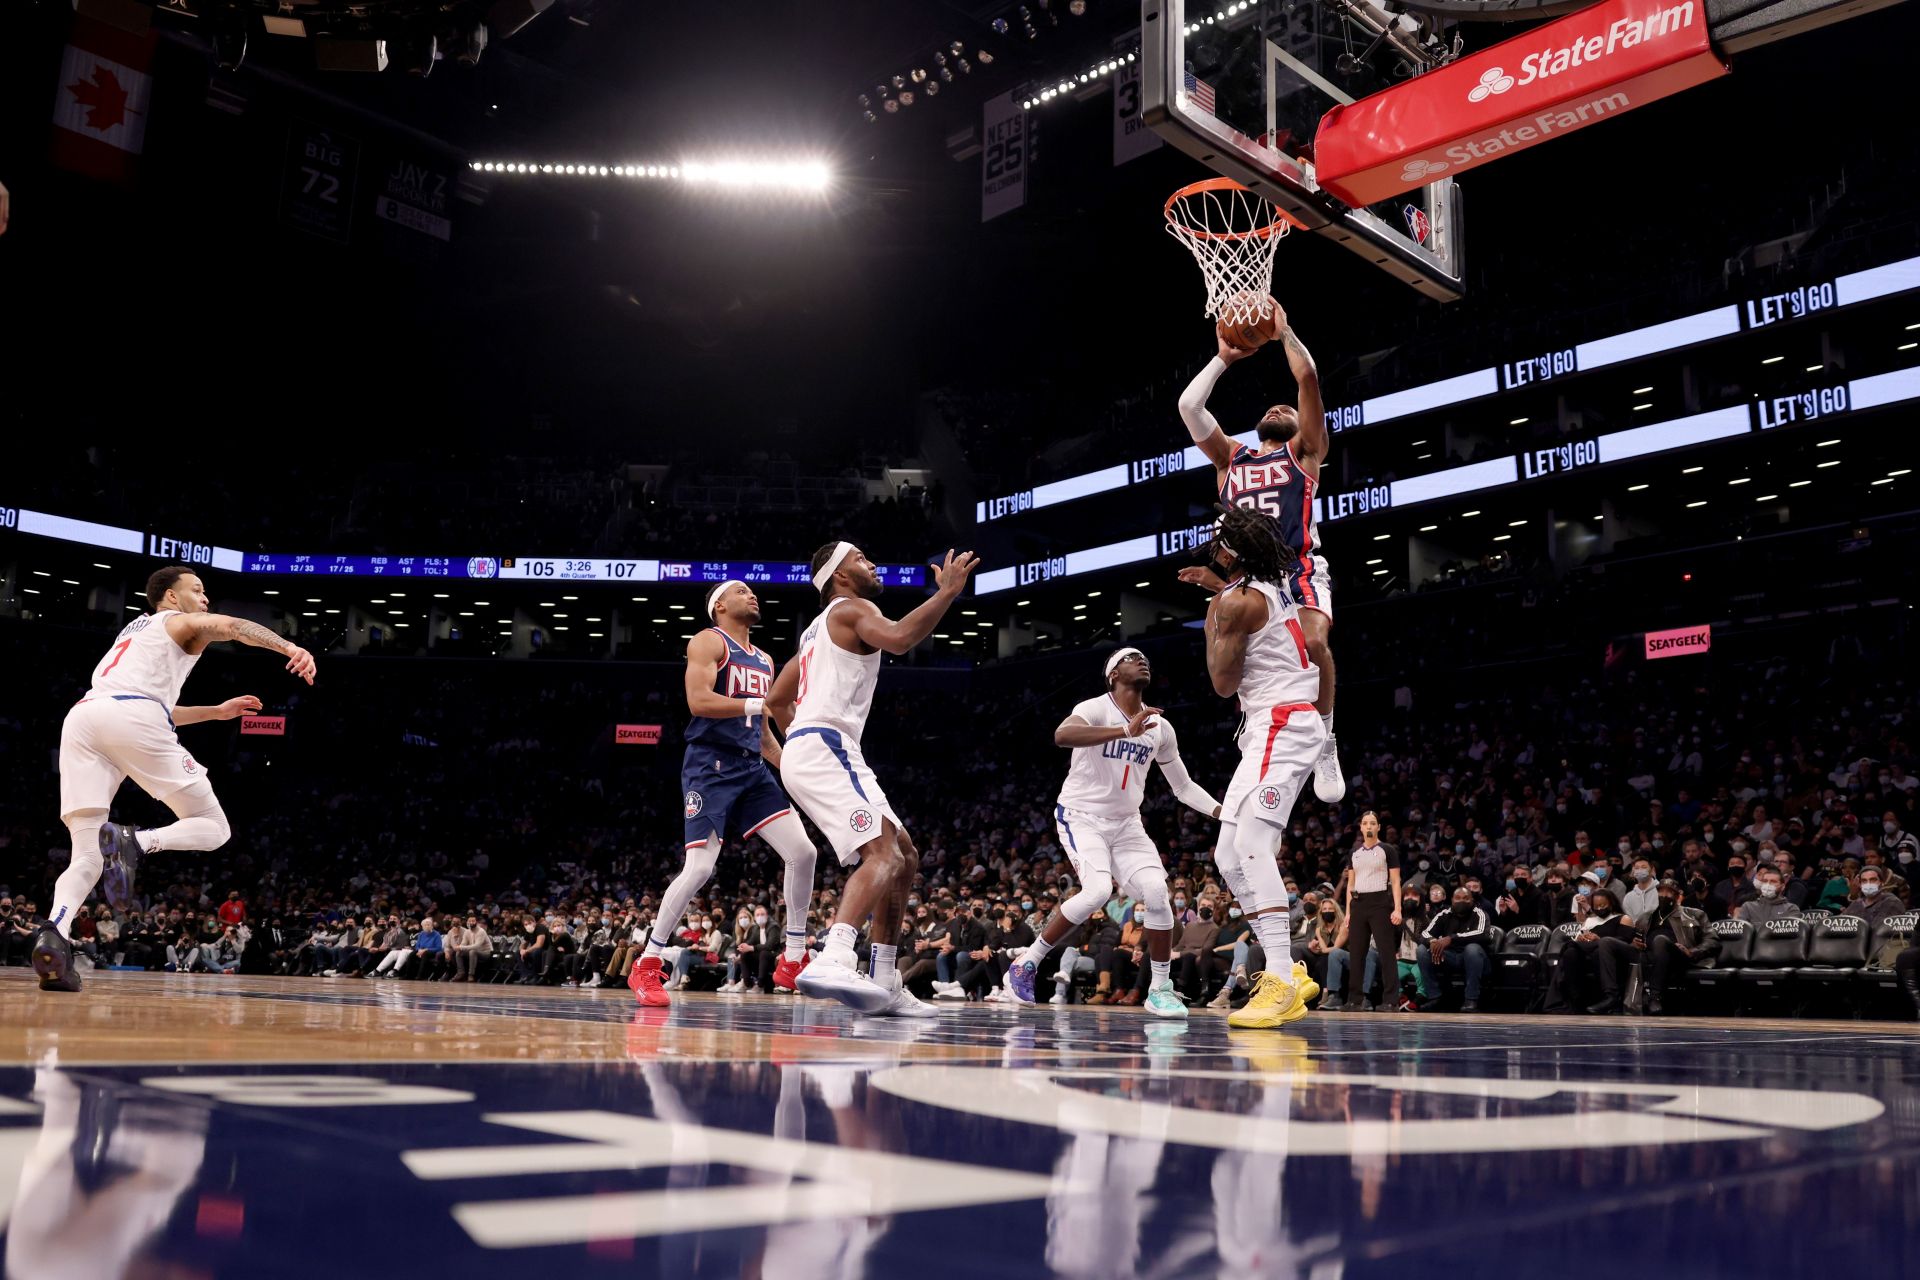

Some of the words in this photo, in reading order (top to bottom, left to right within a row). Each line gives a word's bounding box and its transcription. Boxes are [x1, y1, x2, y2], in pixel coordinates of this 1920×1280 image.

[988, 114, 1022, 145] NETS
[986, 132, 1022, 180] 25
[300, 166, 339, 204] 72
[390, 160, 429, 190] JAY
[435, 173, 447, 197] Z
[1808, 282, 1834, 310] GO
[1554, 349, 1575, 374] GO
[1820, 385, 1846, 414] GO
[1344, 404, 1361, 426] GO
[1574, 439, 1596, 466] GO
[1167, 451, 1182, 473] GO
[1227, 460, 1290, 501] NETS
[1018, 491, 1032, 511] GO
[1371, 486, 1389, 509] GO
[193, 544, 211, 564] GO
[371, 557, 388, 565] REB
[424, 558, 442, 566] FLS:
[374, 566, 383, 574] 37
[424, 567, 442, 575] TOL:
[524, 561, 555, 577] 105
[565, 561, 592, 572] 3:26
[605, 562, 637, 578] 107
[660, 564, 692, 580] NETS
[703, 563, 721, 571] FLS:
[722, 563, 728, 571] 5
[875, 566, 888, 574] EB
[899, 567, 916, 575] AST
[1051, 557, 1065, 577] GO
[703, 572, 721, 580] TOL:
[901, 576, 911, 584] 24
[1649, 632, 1707, 652] SEATGEEK
[101, 638, 132, 677] 7
[243, 720, 282, 730] SEATGEEK
[618, 730, 658, 739] SEATGEEK
[1121, 764, 1130, 790] 1
[1513, 926, 1543, 935] QATAR
[1560, 924, 1581, 933] QATA
[1711, 921, 1745, 930] QATAR
[1765, 920, 1800, 929] QATAR
[1823, 918, 1859, 927] QATAR
